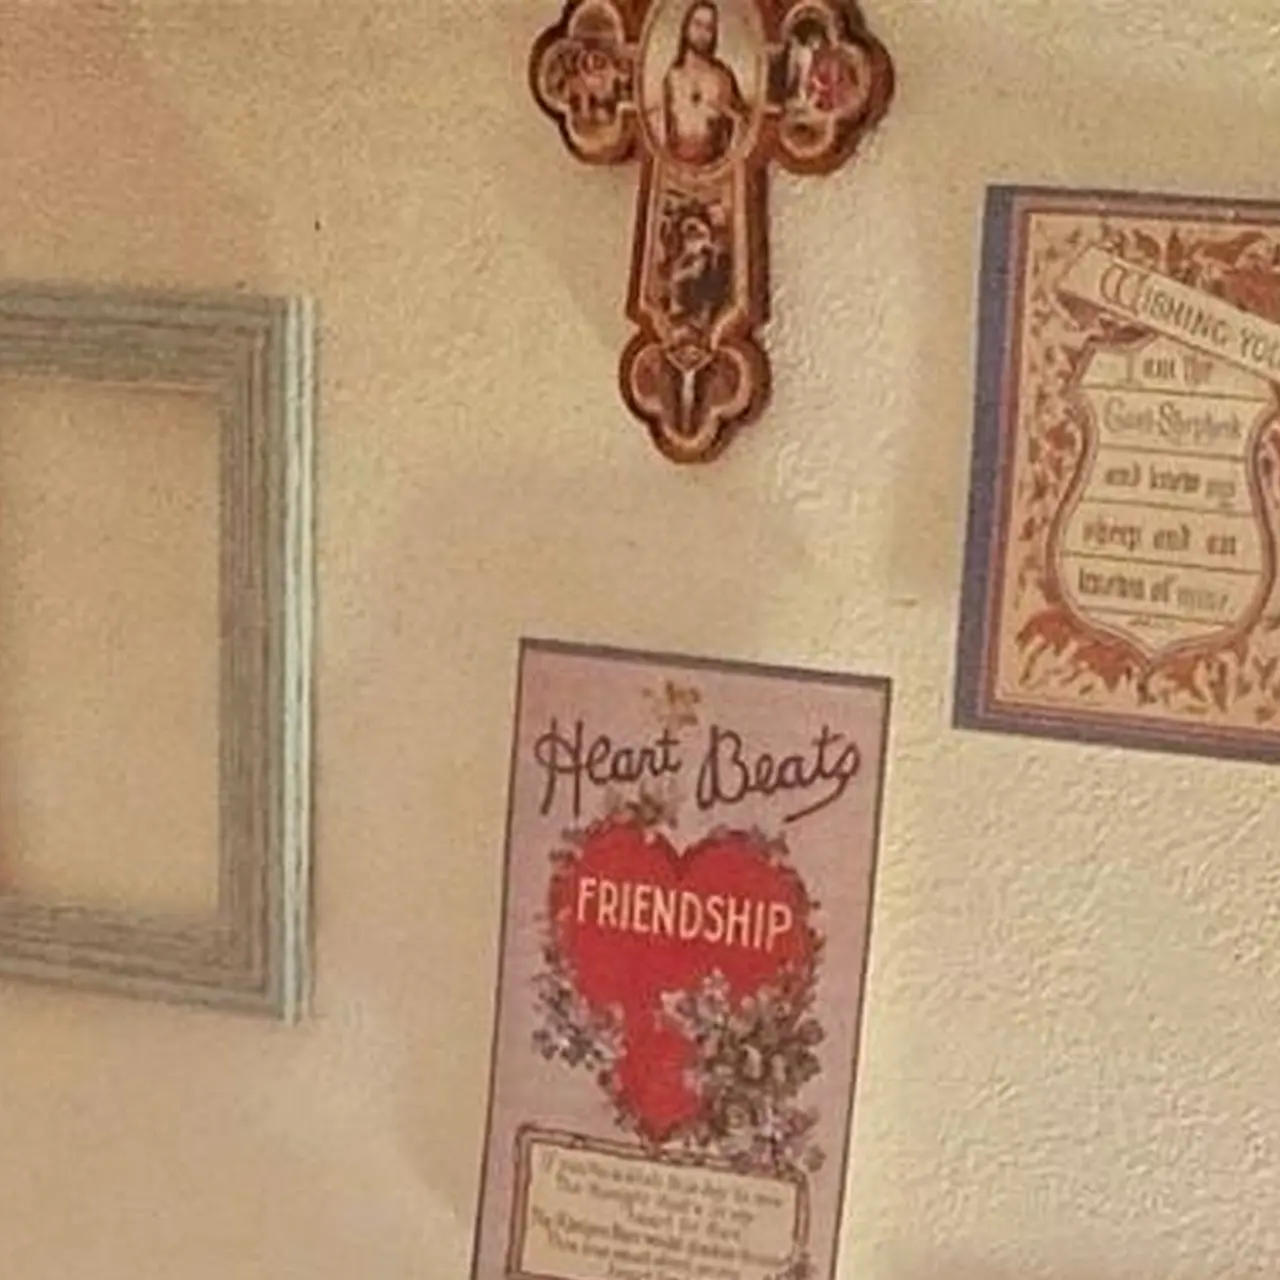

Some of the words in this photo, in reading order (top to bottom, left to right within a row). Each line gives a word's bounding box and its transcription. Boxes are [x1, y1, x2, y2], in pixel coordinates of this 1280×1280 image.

[533, 716, 684, 818] Heart
[696, 723, 862, 825] Beats
[576, 876, 794, 952] FRIENDSHIP
